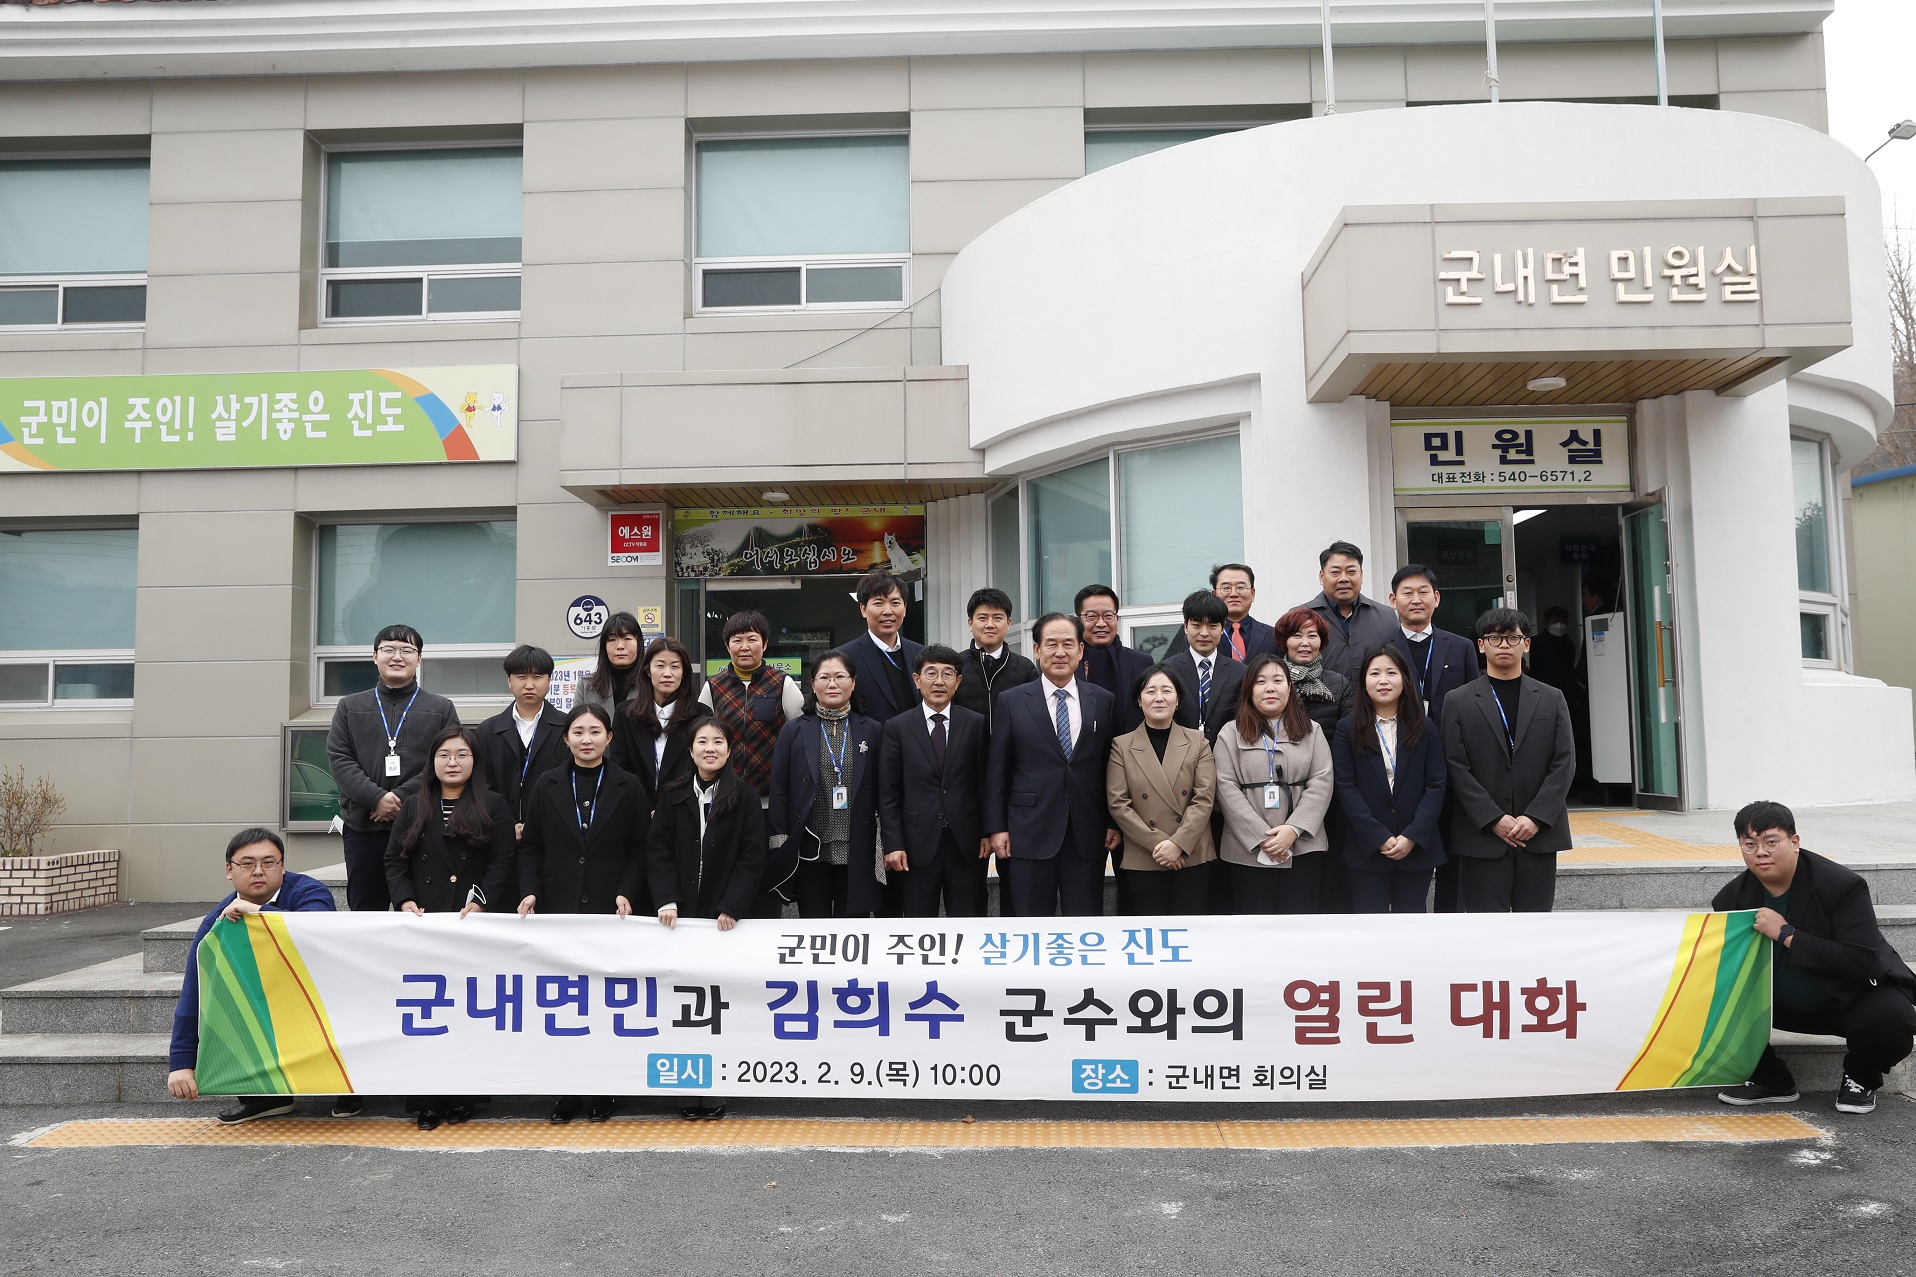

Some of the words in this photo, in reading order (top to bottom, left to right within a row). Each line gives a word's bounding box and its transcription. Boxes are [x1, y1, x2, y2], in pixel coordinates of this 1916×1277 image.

[1438, 246, 1588, 305] 군내면
[1609, 244, 1761, 302] 민원실
[19, 397, 107, 445] 군민이
[124, 394, 195, 443] 주인!
[210, 390, 330, 443] 살기좋은
[347, 390, 405, 437] 진도
[618, 525, 652, 539] 에스원
[611, 555, 639, 563] SECOM
[573, 611, 603, 626] 643
[776, 932, 870, 966] 군민이
[886, 932, 965, 966] 주인!
[979, 931, 1107, 967] 살기좋은
[1121, 927, 1193, 965] 진도
[395, 974, 730, 1038] 군내면민과
[765, 978, 965, 1040] 김희수
[1000, 987, 1244, 1043] 군수와의
[1283, 979, 1415, 1045] 열린
[1450, 977, 1587, 1040] 대화
[655, 1058, 705, 1085] 일시
[737, 1060, 807, 1086] 2023.
[930, 1062, 1001, 1087] 10:00
[1079, 1063, 1132, 1090] 장소
[1165, 1064, 1242, 1090] 군내면
[1252, 1064, 1328, 1090] 회의실
